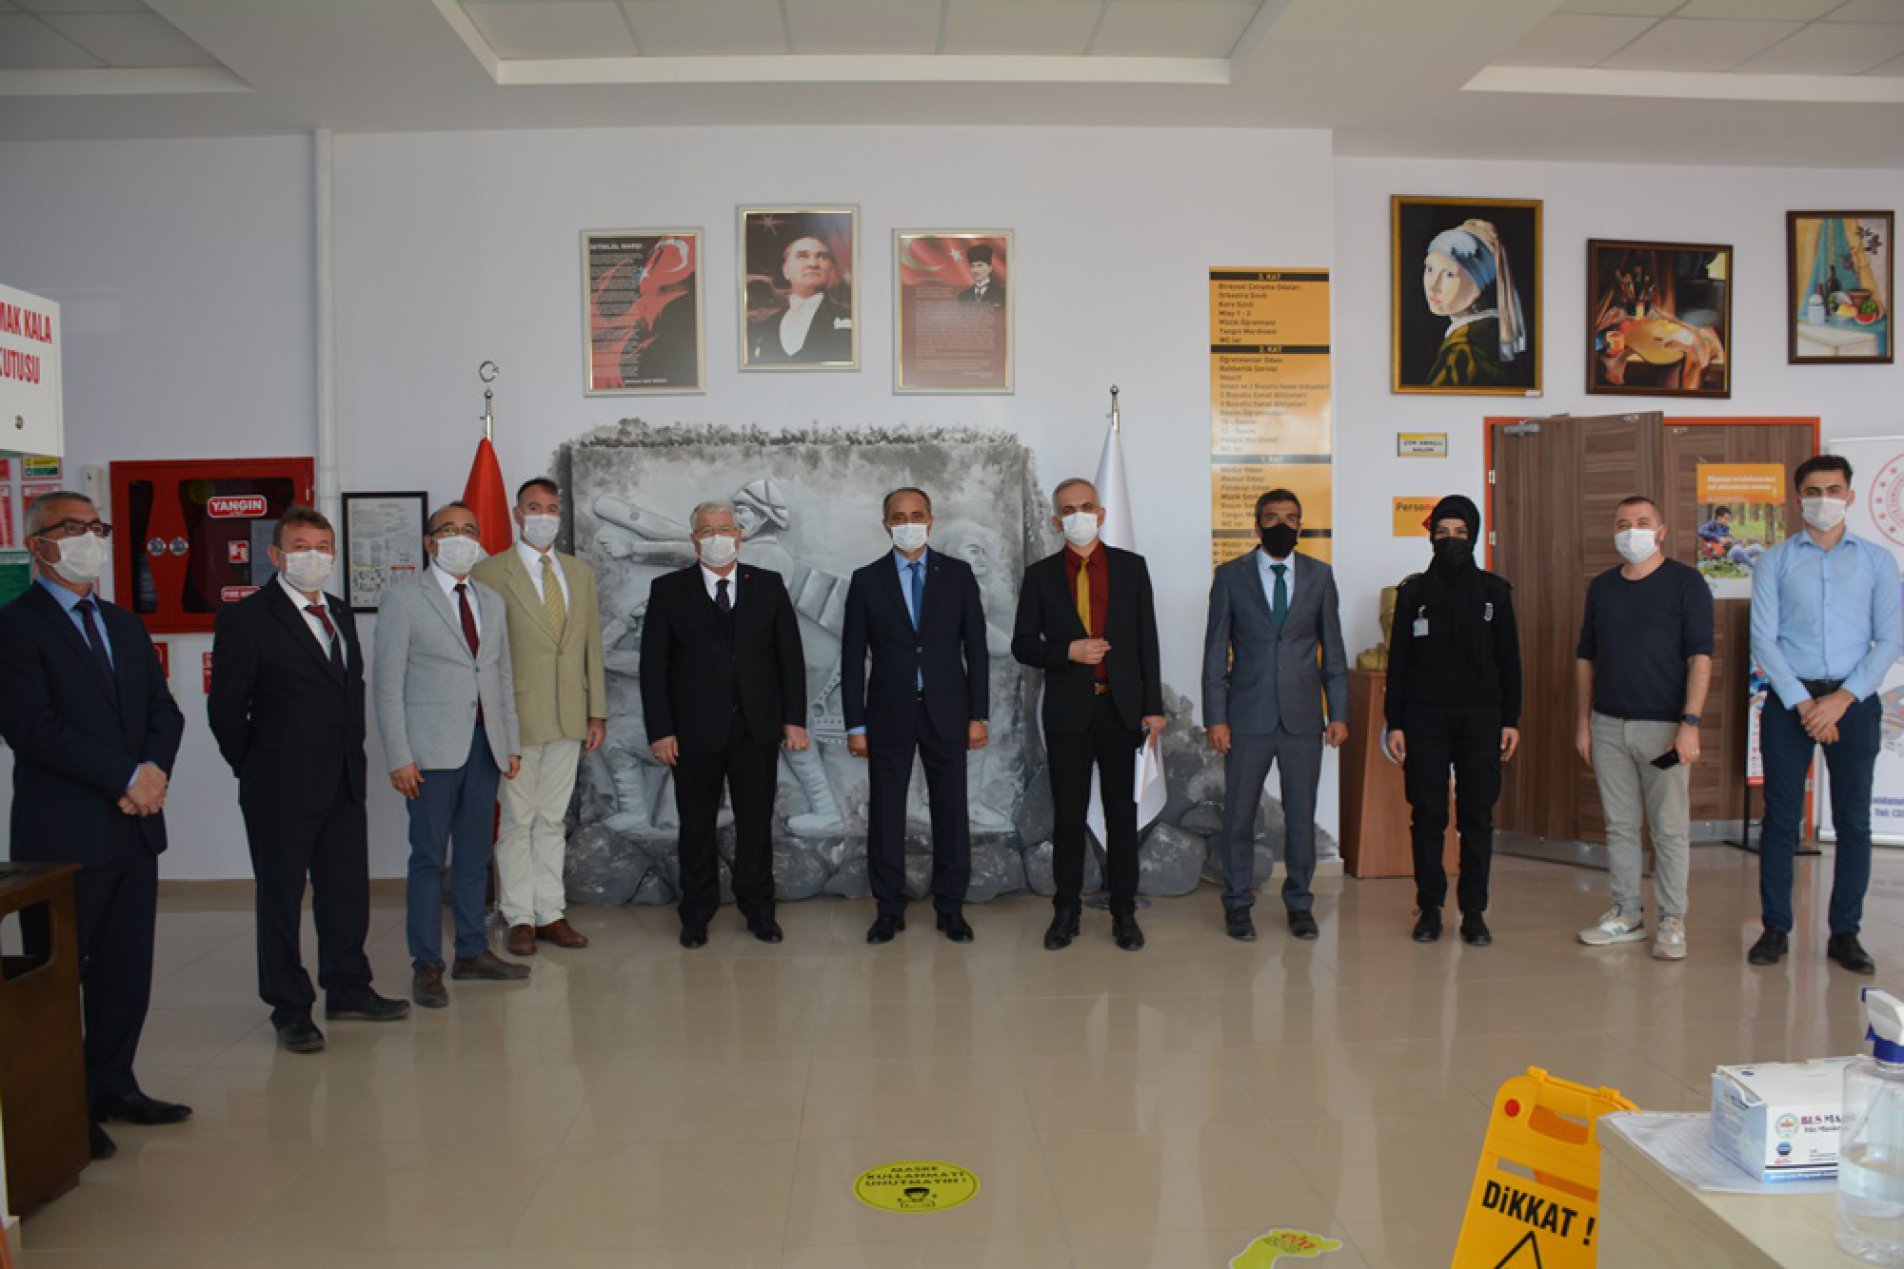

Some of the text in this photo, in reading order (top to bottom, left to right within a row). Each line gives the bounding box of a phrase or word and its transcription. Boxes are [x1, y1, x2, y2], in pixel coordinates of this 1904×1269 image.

[24, 307, 52, 345] KALA
[0, 347, 41, 385] UTUSU
[211, 499, 262, 511] YANGIN
